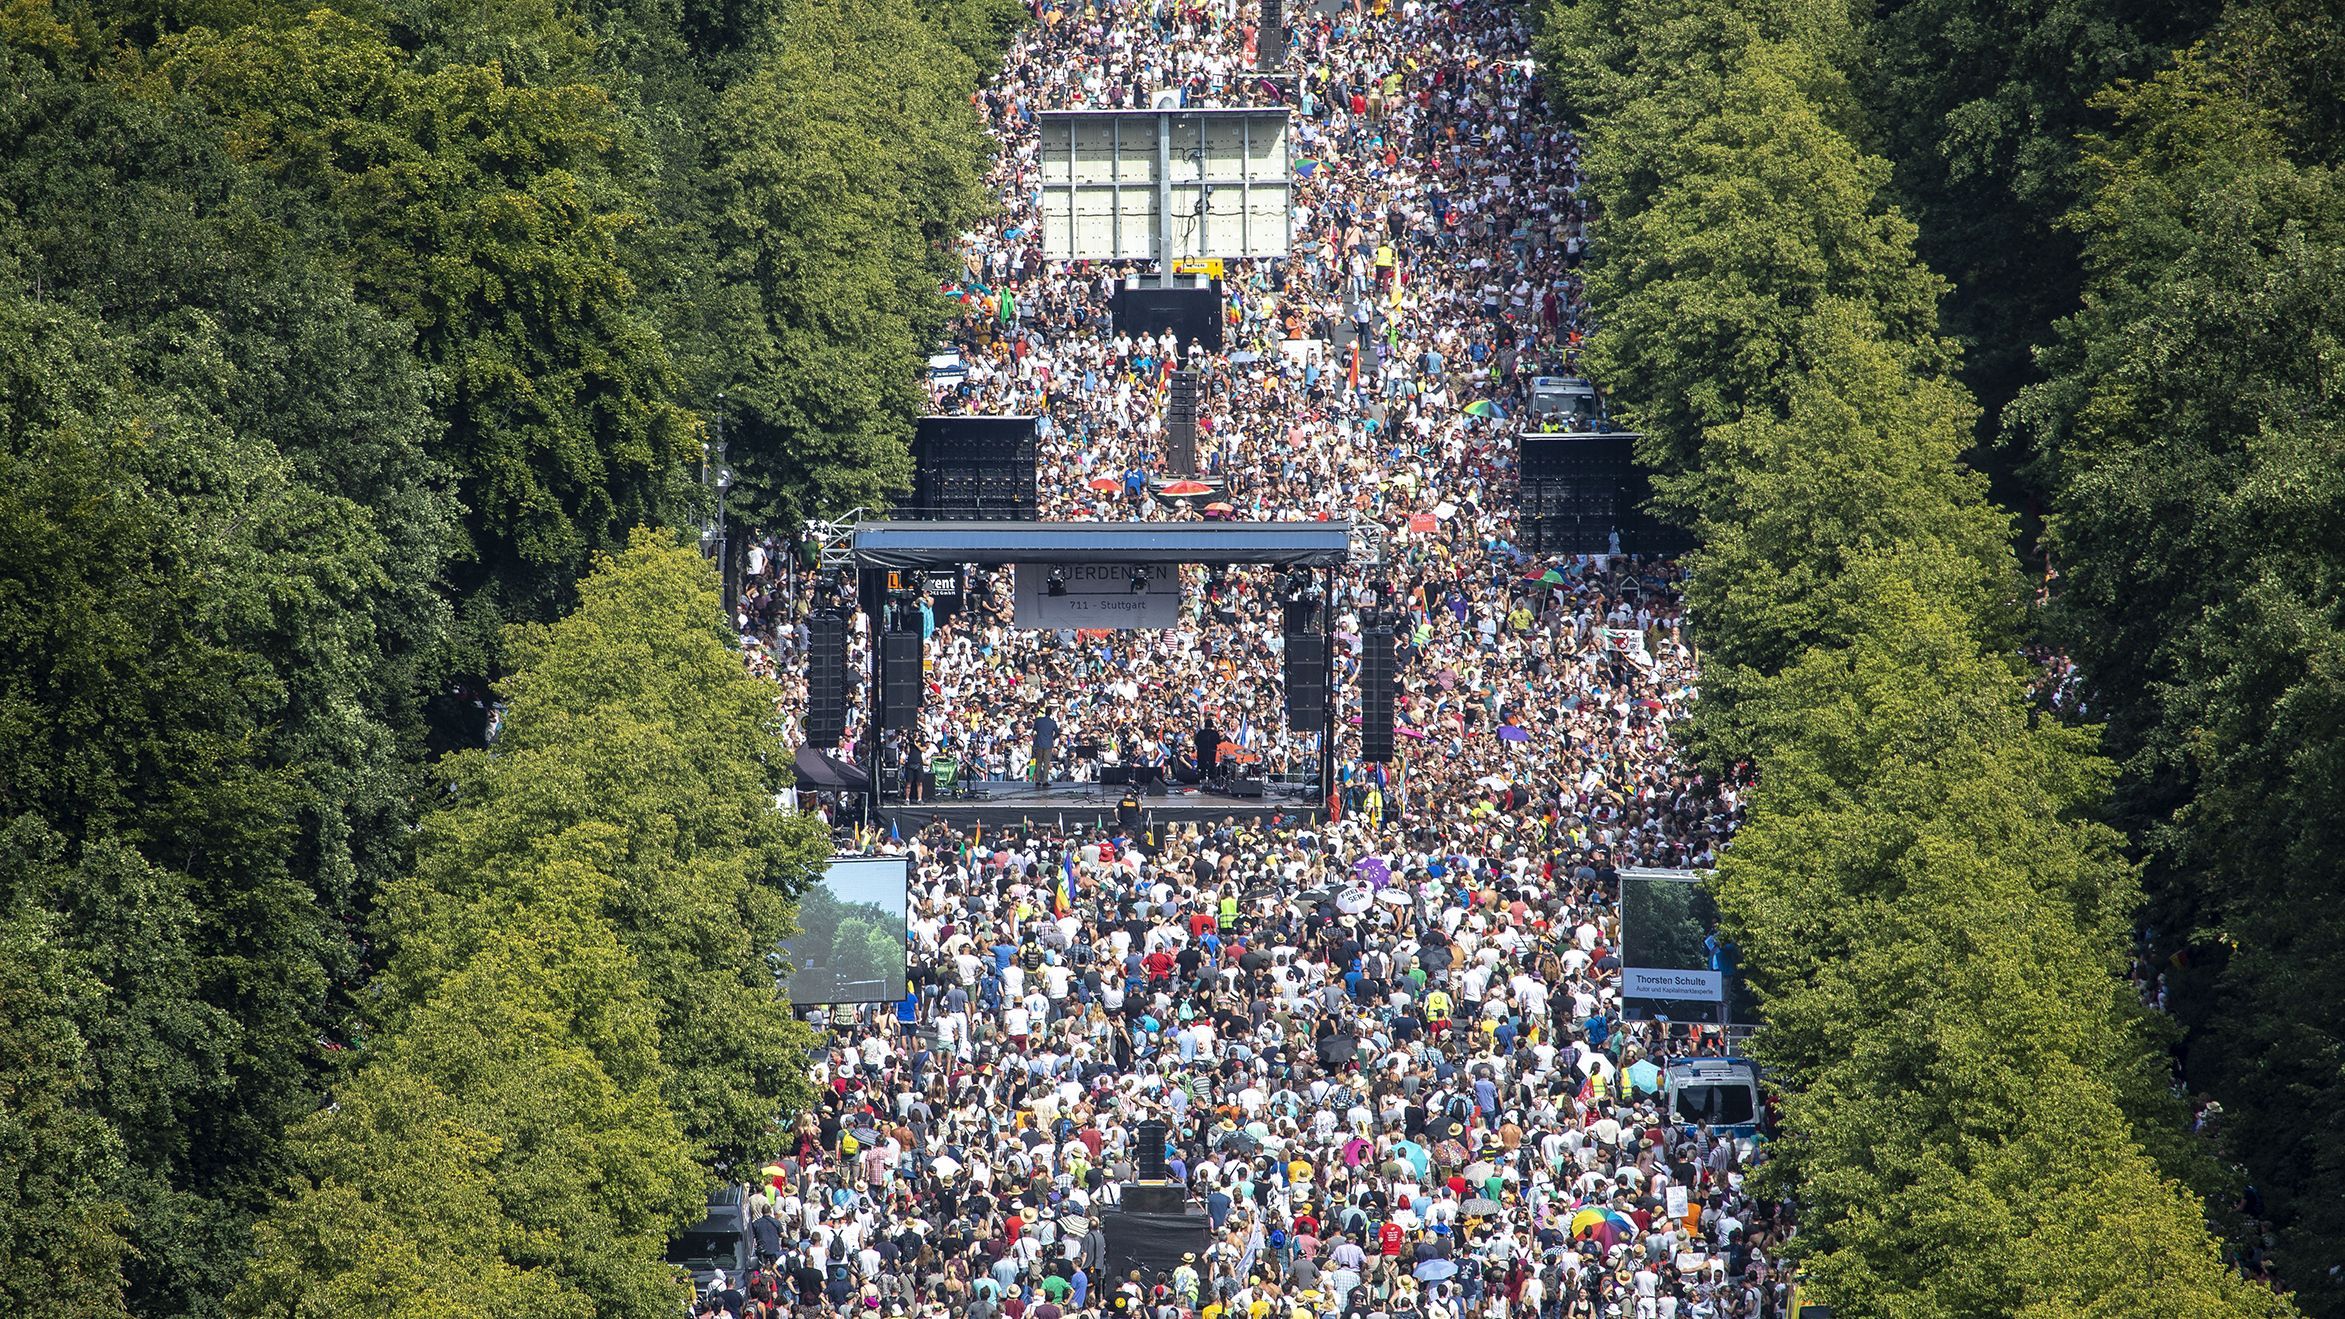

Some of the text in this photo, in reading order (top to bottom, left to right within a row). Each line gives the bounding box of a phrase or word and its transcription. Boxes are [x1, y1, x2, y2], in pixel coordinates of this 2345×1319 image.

[1053, 566, 1167, 580] UERDENEN
[1069, 600, 1088, 610] 711
[1100, 600, 1146, 612] Stuttgart
[1341, 888, 1359, 899] FREI
[1347, 893, 1366, 904] SEIN
[1635, 974, 1706, 986] Thorsten Schulte
[1662, 987, 1714, 995] Kapitalmarktexperte
